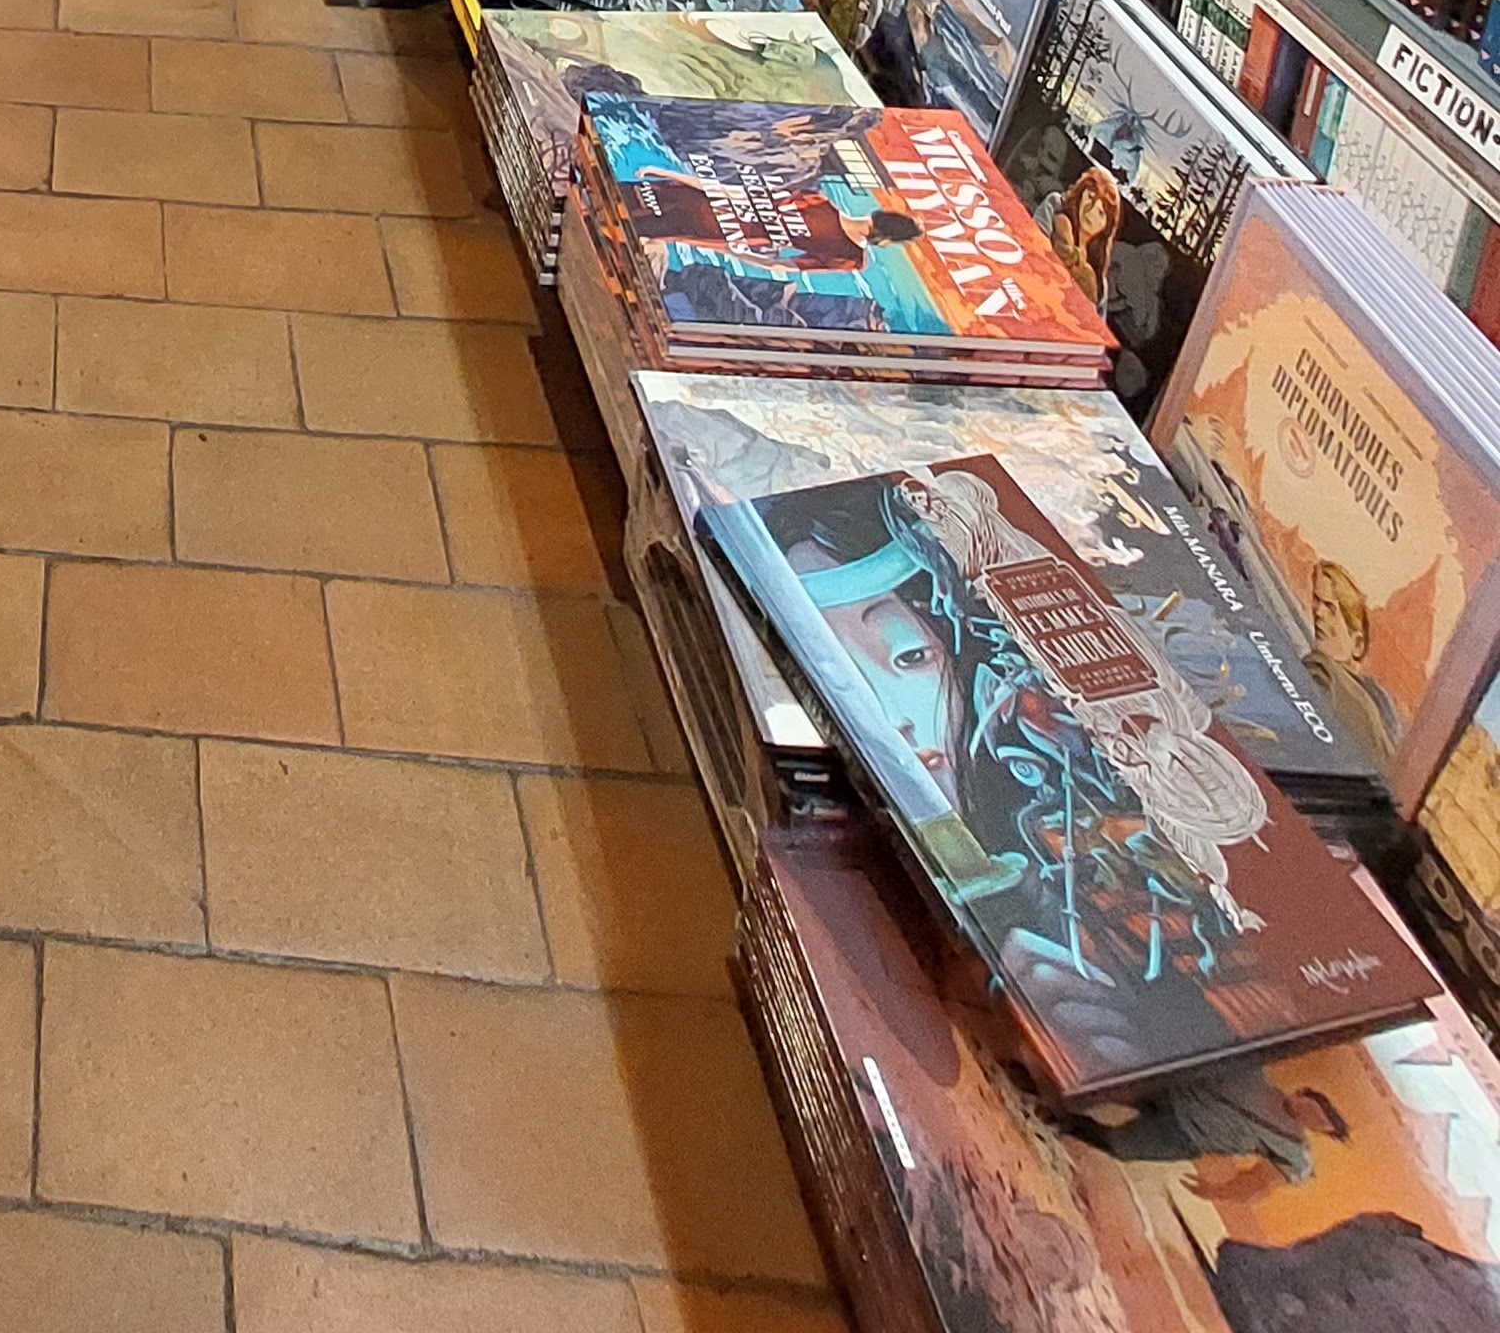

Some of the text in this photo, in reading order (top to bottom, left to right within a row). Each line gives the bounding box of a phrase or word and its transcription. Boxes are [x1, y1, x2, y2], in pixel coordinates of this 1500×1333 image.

[881, 159, 1023, 321] HYMAN
[902, 123, 1025, 265] MUSSO
[1271, 363, 1404, 543] DIPLOMATIQUES
[1295, 347, 1404, 493] CHRONIQUES
[1019, 602, 1105, 635] FEMMES
[1038, 625, 1133, 669] SAMURAI
[1183, 537, 1245, 614] MANARA
[1249, 630, 1300, 704] Umberto
[1294, 698, 1334, 746] ECO
